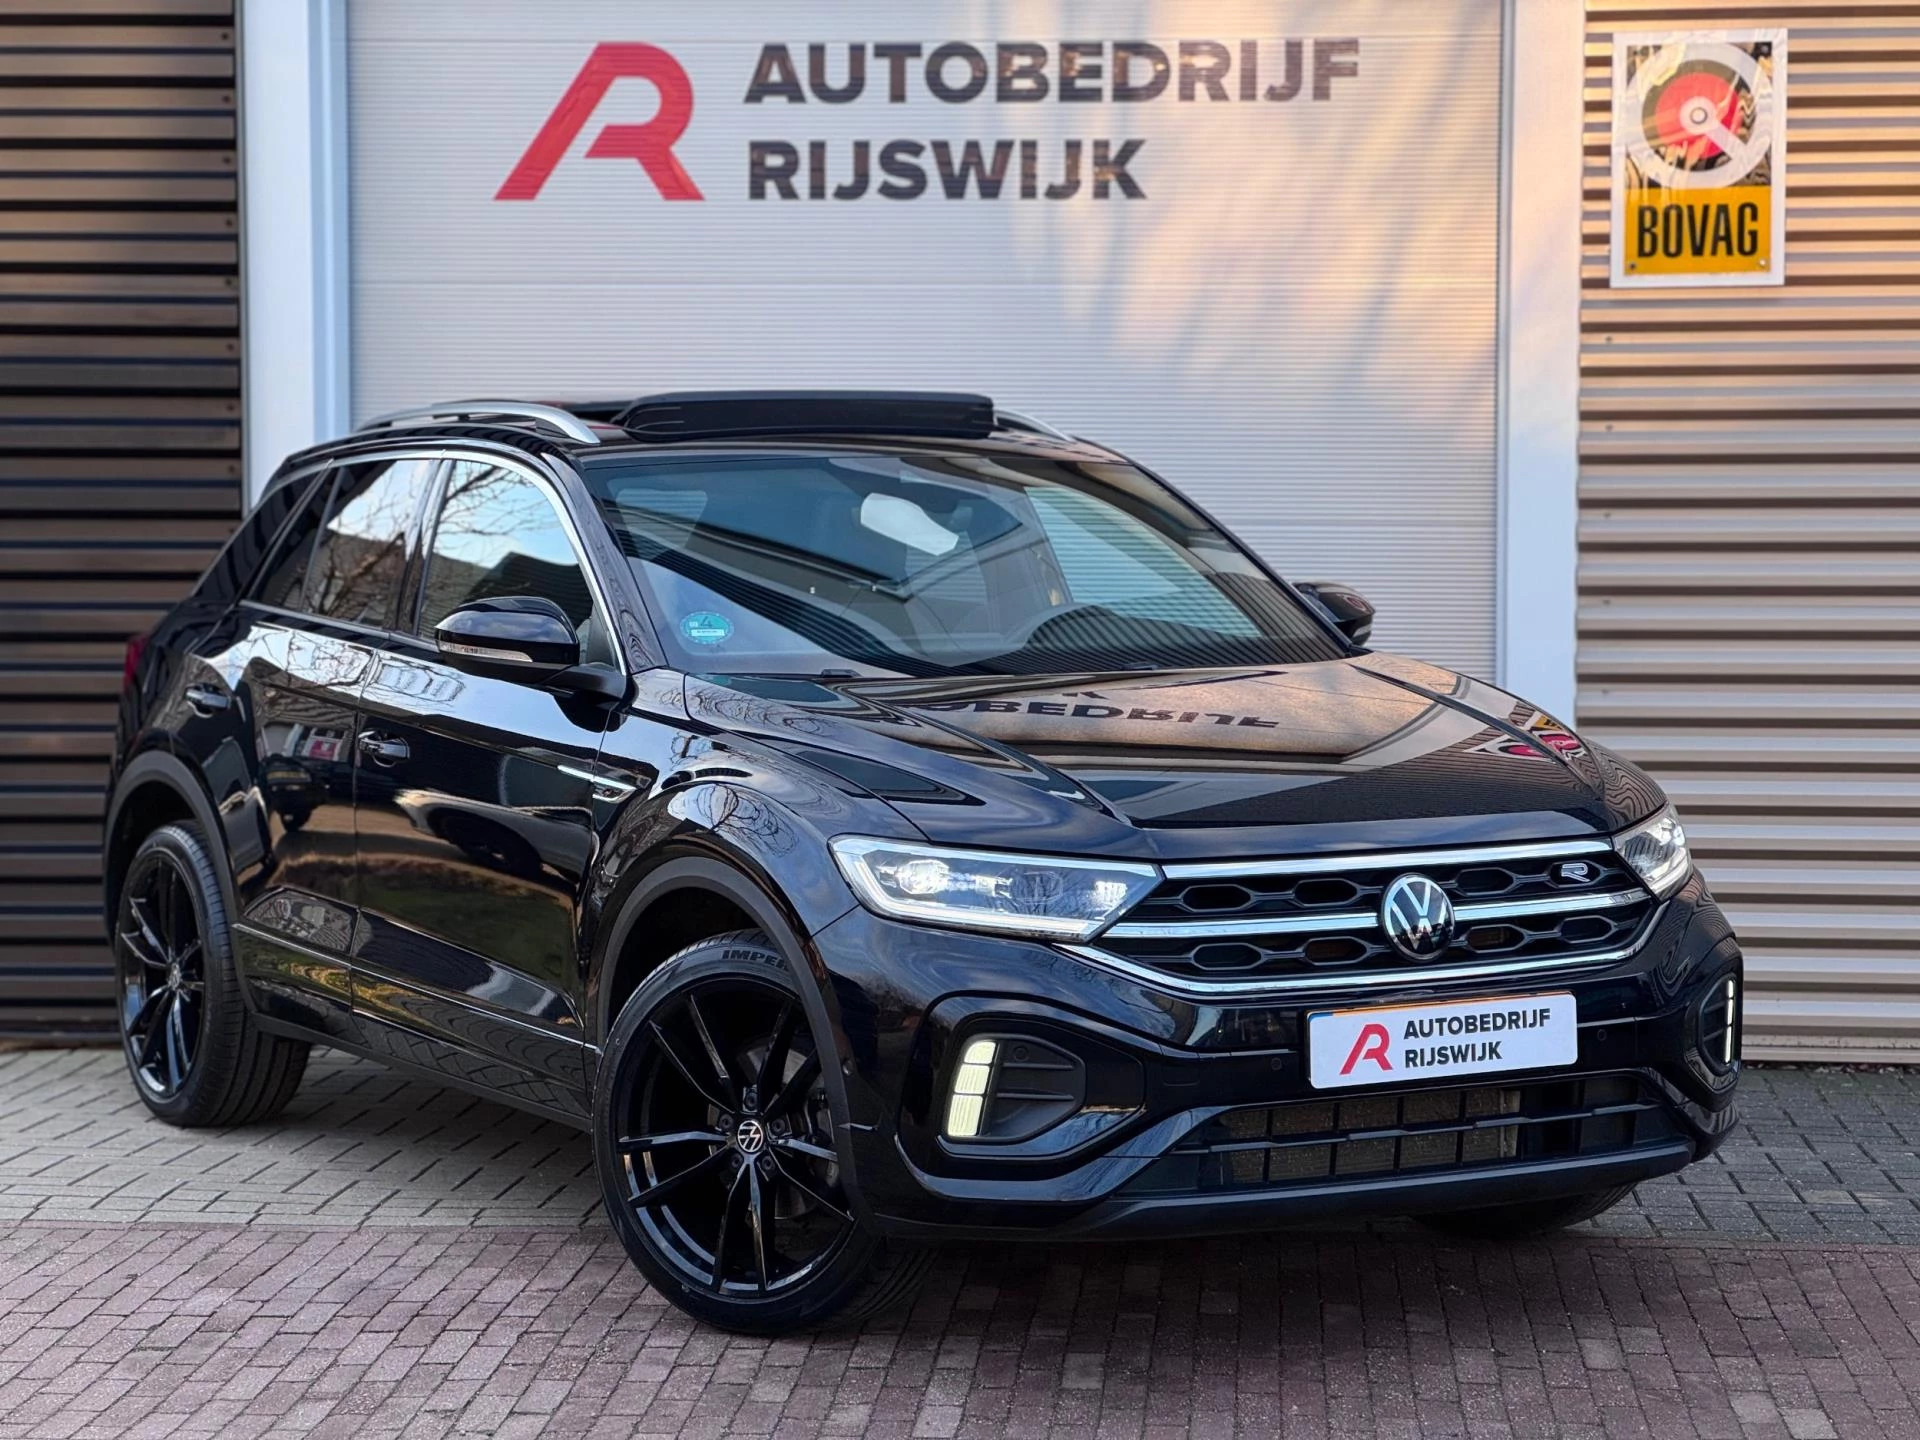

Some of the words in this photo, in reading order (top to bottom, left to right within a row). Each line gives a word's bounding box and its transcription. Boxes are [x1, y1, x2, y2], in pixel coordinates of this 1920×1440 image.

[743, 38, 1359, 103] AUTOBEDRIJF
[748, 138, 1148, 201] RIJSWIJK
[1637, 202, 1758, 258] BOVAG
[1560, 862, 1591, 883] R
[1403, 1008, 1551, 1040] AUTOBEDRIJF
[1404, 1041, 1503, 1068] RIJSWIJK
